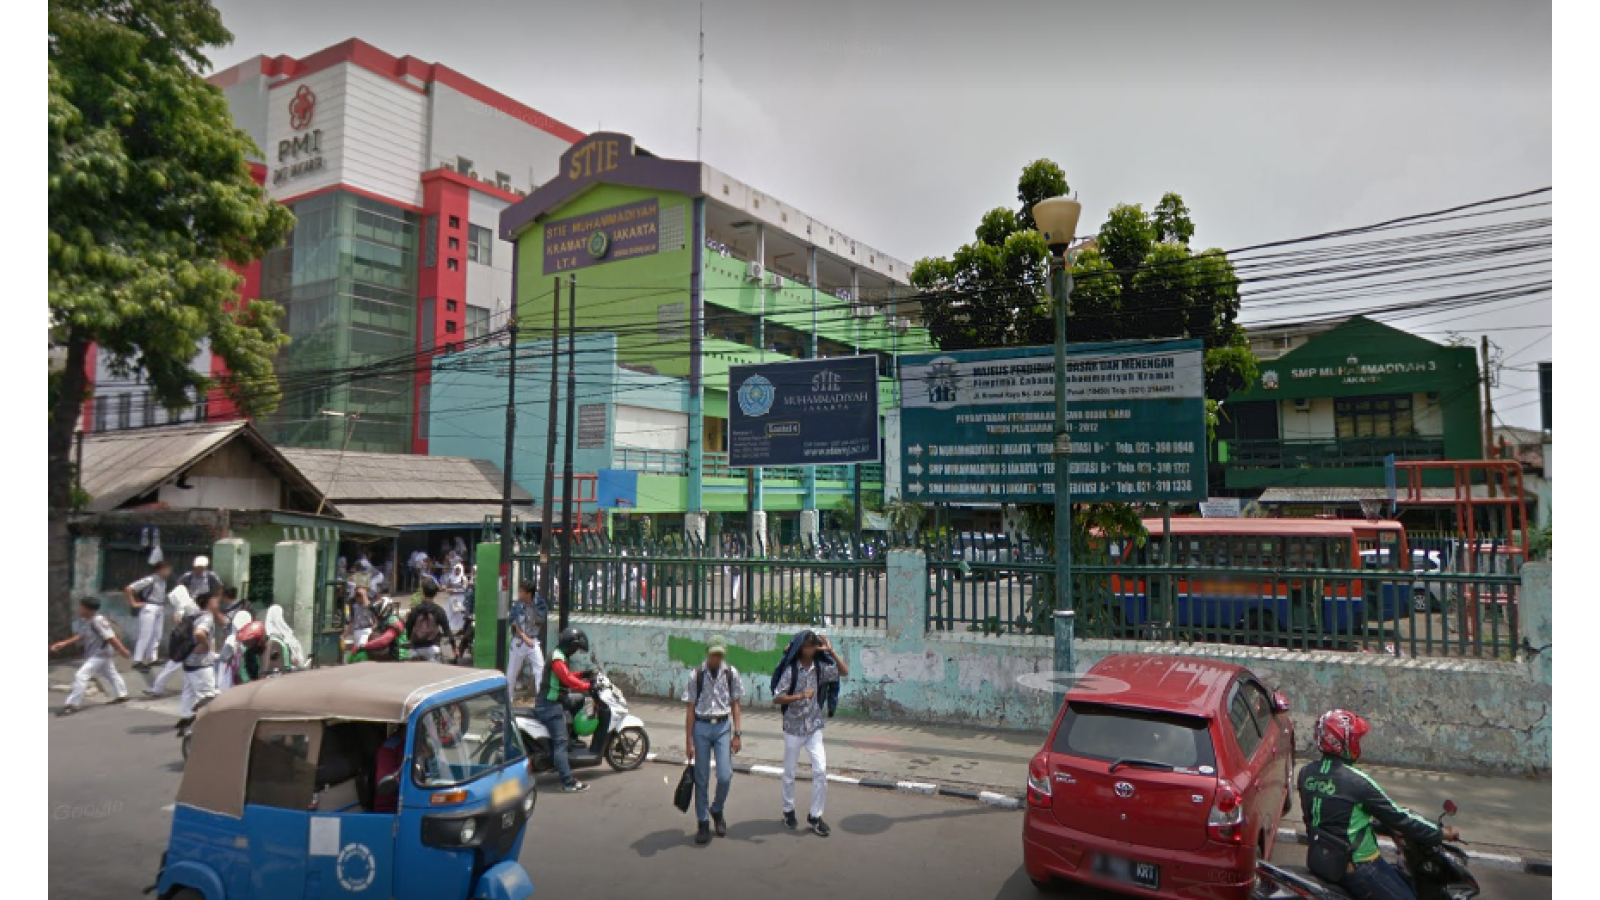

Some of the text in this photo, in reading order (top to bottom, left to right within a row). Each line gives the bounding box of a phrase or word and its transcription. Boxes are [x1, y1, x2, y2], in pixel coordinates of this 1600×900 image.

[277, 129, 323, 162] PMI
[569, 140, 619, 180] STIE
[546, 204, 657, 240] STIE MUHAMMADIYAH
[613, 222, 656, 241] JAKARTA
[546, 237, 588, 255] KRAMAT
[1099, 359, 1120, 371] DAN
[1121, 357, 1175, 369] MENENGAH
[1291, 366, 1317, 379] SMP
[1428, 360, 1437, 371] 3
[811, 368, 841, 391] STIE
[1065, 371, 1135, 383] uhammadiyah
[1138, 371, 1175, 381] Kramat
[783, 391, 869, 406] MUHAMMADIYAH
[1078, 422, 1099, 433] 2012
[1305, 776, 1336, 795] Grab
[1136, 861, 1155, 880] KRT
